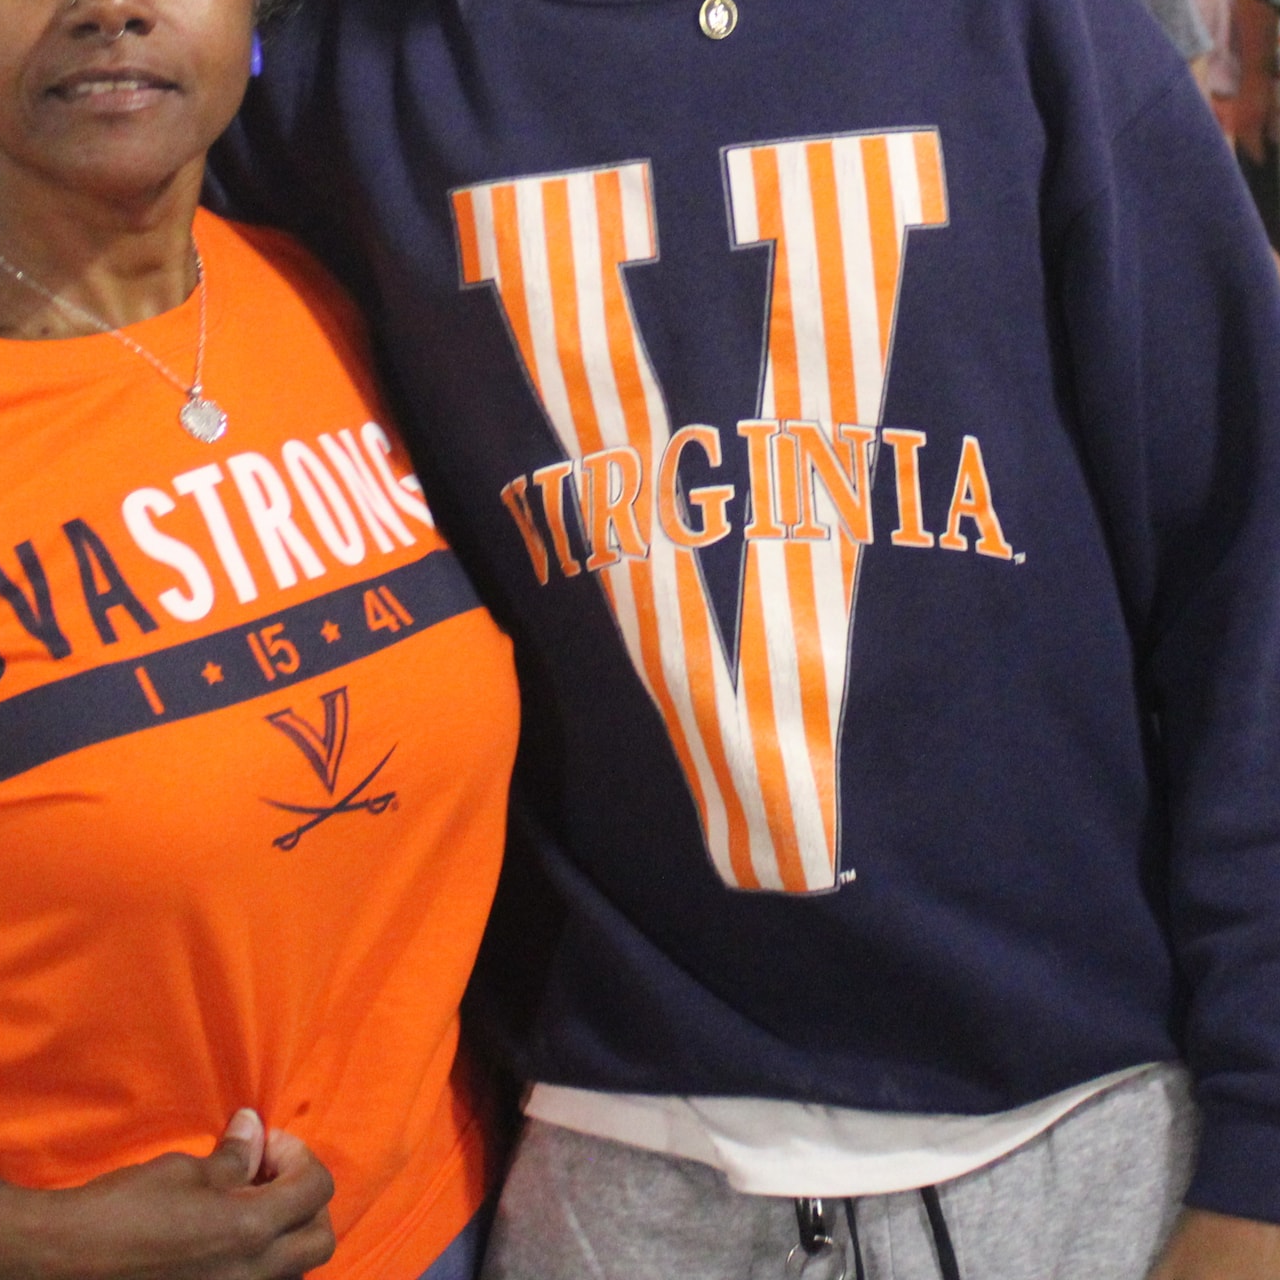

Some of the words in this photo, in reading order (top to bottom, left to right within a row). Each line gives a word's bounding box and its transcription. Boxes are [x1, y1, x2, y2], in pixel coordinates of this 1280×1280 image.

[448, 125, 949, 896] V
[500, 420, 1013, 586] VIRGINIA
[246, 622, 301, 682] 15
[363, 585, 414, 633] 41
